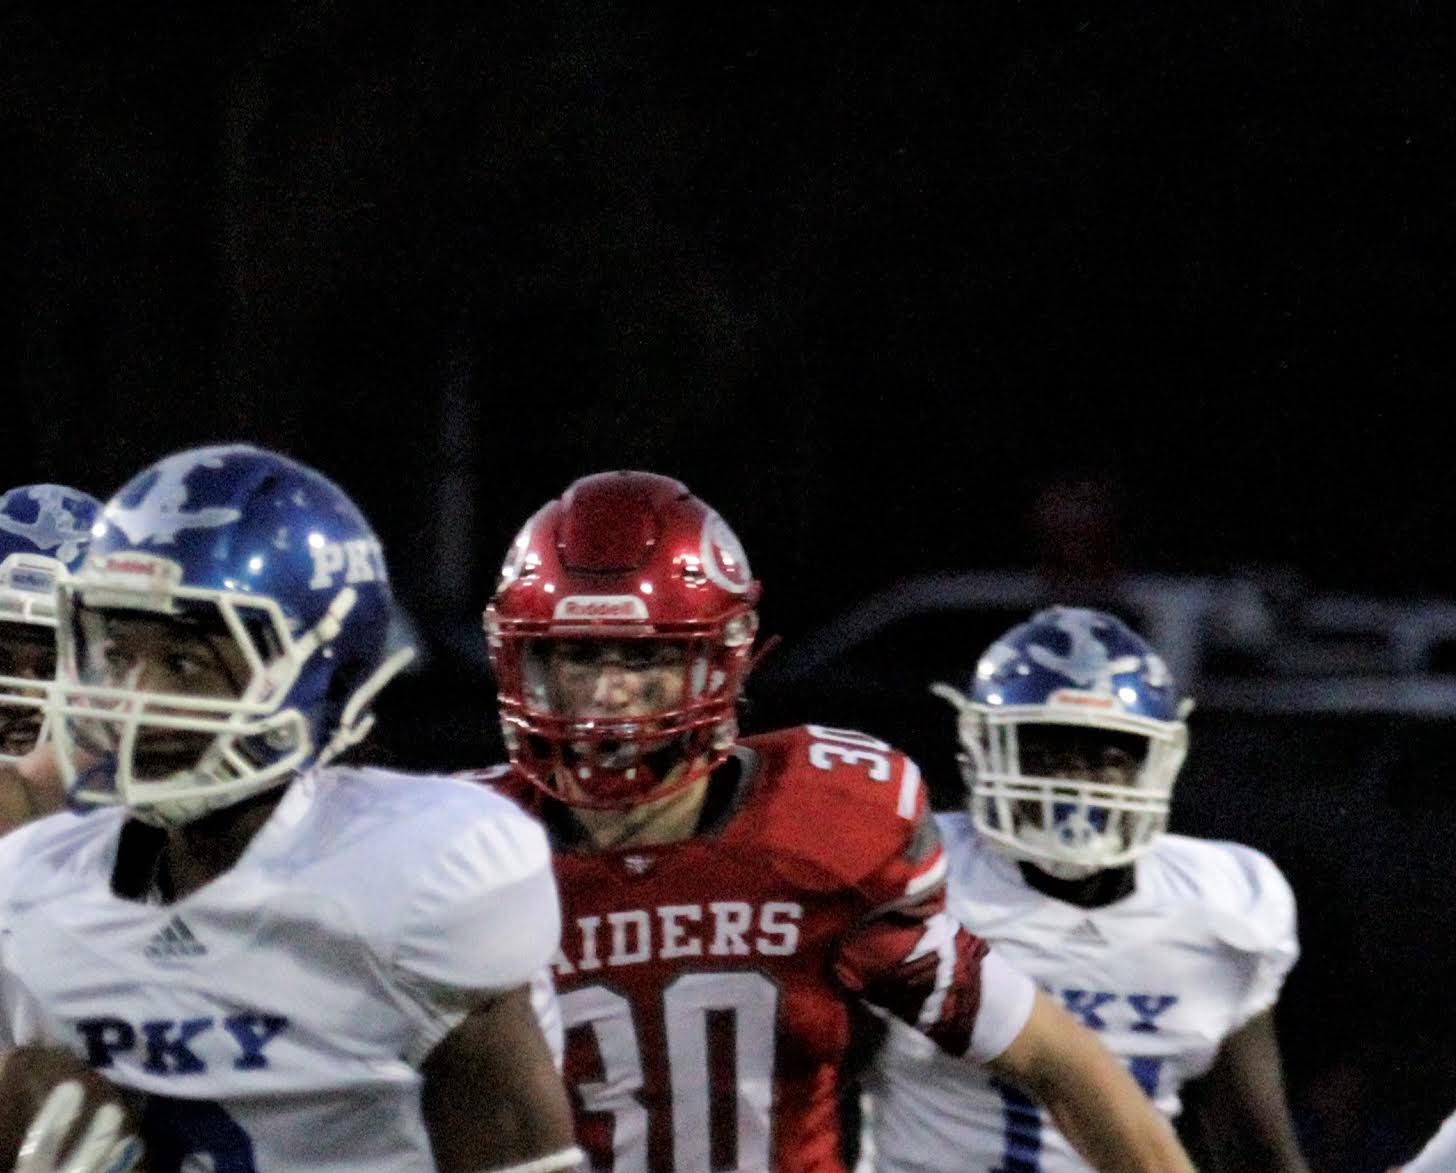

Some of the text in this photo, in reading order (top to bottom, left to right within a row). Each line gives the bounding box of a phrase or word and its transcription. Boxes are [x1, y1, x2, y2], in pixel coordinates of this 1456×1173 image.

[551, 901, 803, 974] IDERS
[1043, 983, 1180, 1034] KY
[75, 1013, 290, 1076] PKY
